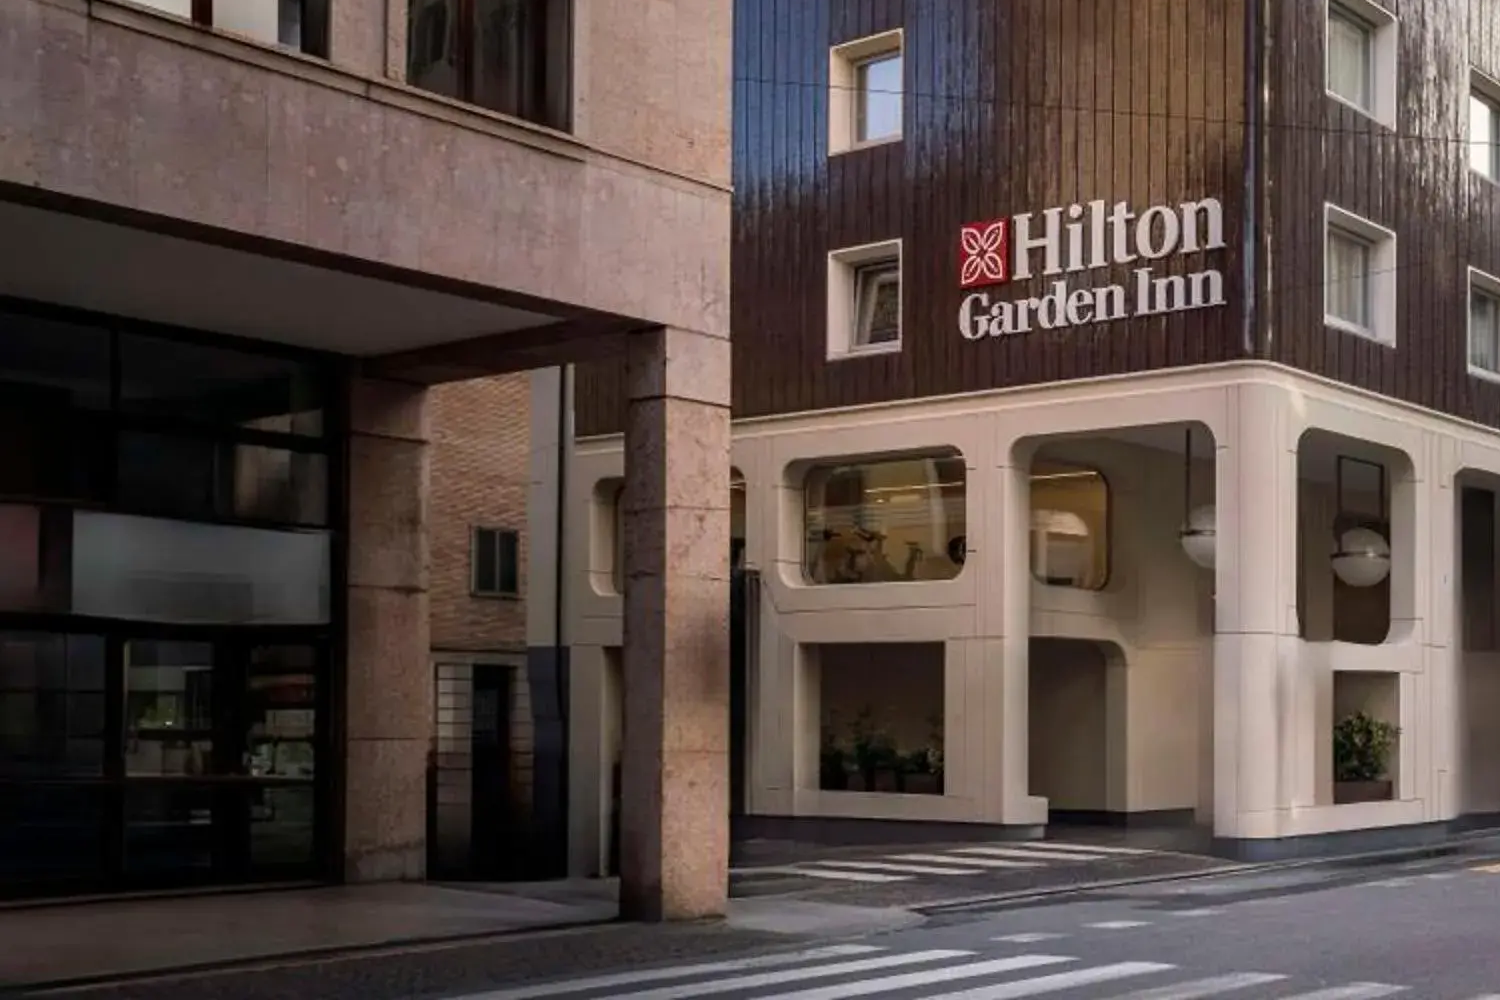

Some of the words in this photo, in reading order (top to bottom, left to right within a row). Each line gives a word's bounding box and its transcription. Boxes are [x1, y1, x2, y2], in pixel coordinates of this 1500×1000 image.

[1012, 198, 1226, 280] Hilton
[959, 281, 1127, 340] Garden
[1133, 268, 1227, 316] Inn
